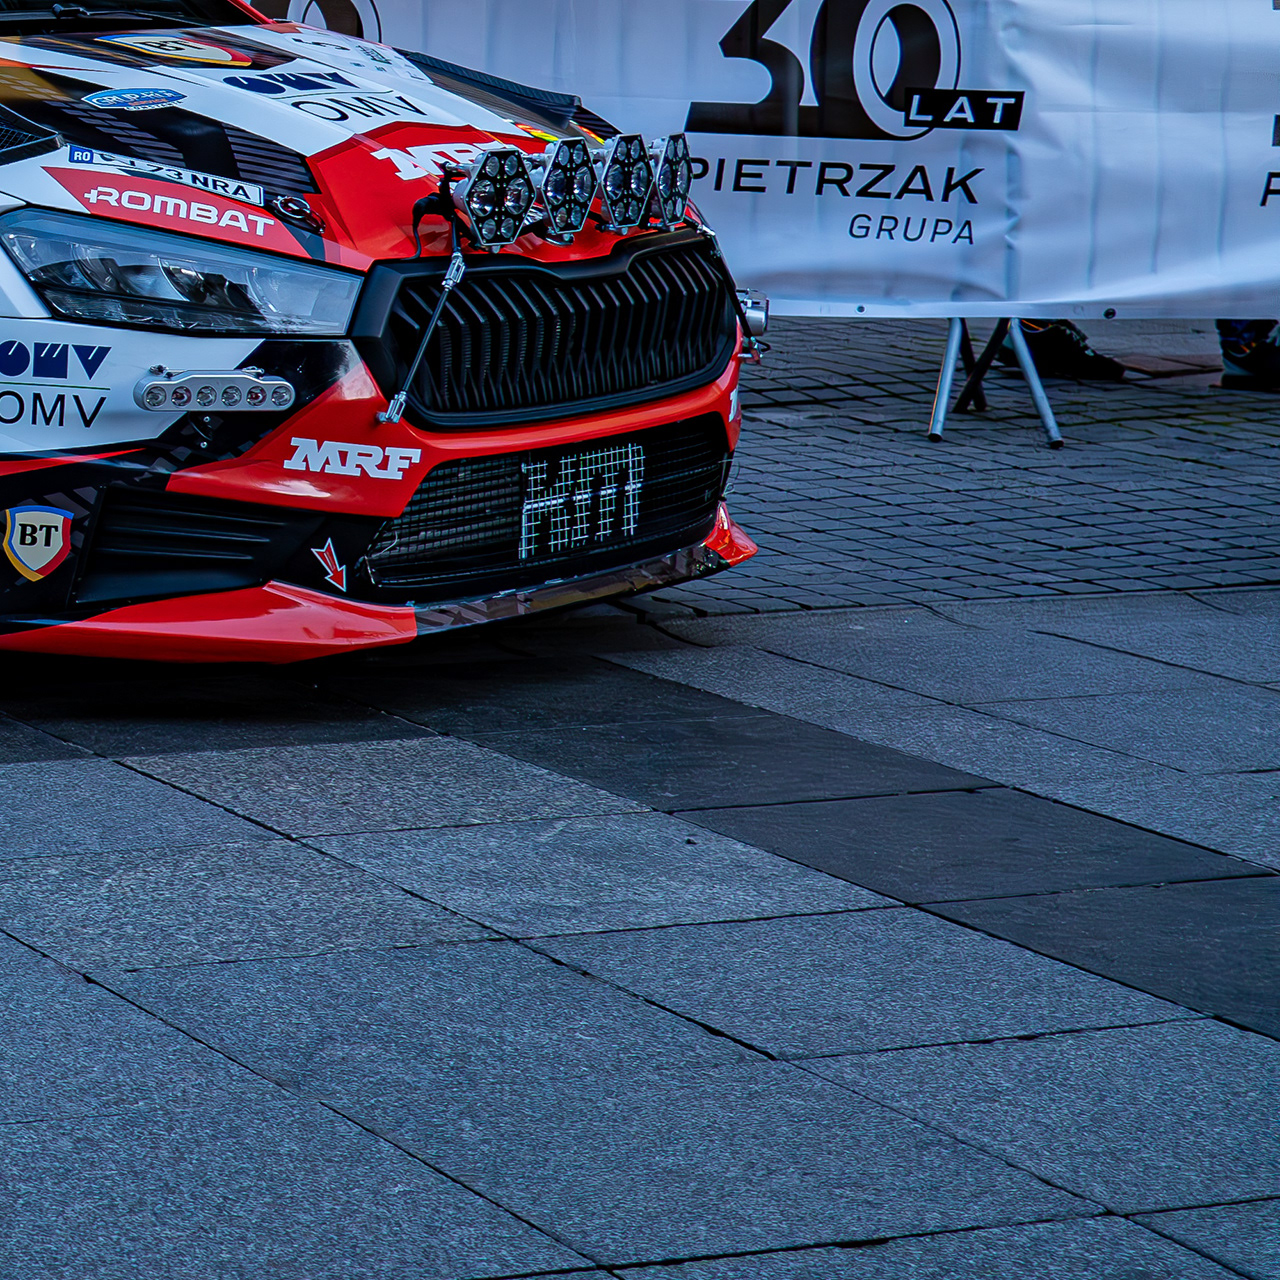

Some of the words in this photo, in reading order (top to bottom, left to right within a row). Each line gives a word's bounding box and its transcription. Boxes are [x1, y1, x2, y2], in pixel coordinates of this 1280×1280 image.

[290, 95, 427, 122] OMV
[909, 94, 1017, 124] LAT
[73, 150, 91, 162] RO
[190, 173, 251, 200] NRA
[688, 157, 986, 205] PIETRZAK
[84, 184, 275, 237] ROMBAT
[847, 212, 975, 245] GRUPA
[283, 436, 421, 481] MRF
[18, 523, 60, 548] BT
